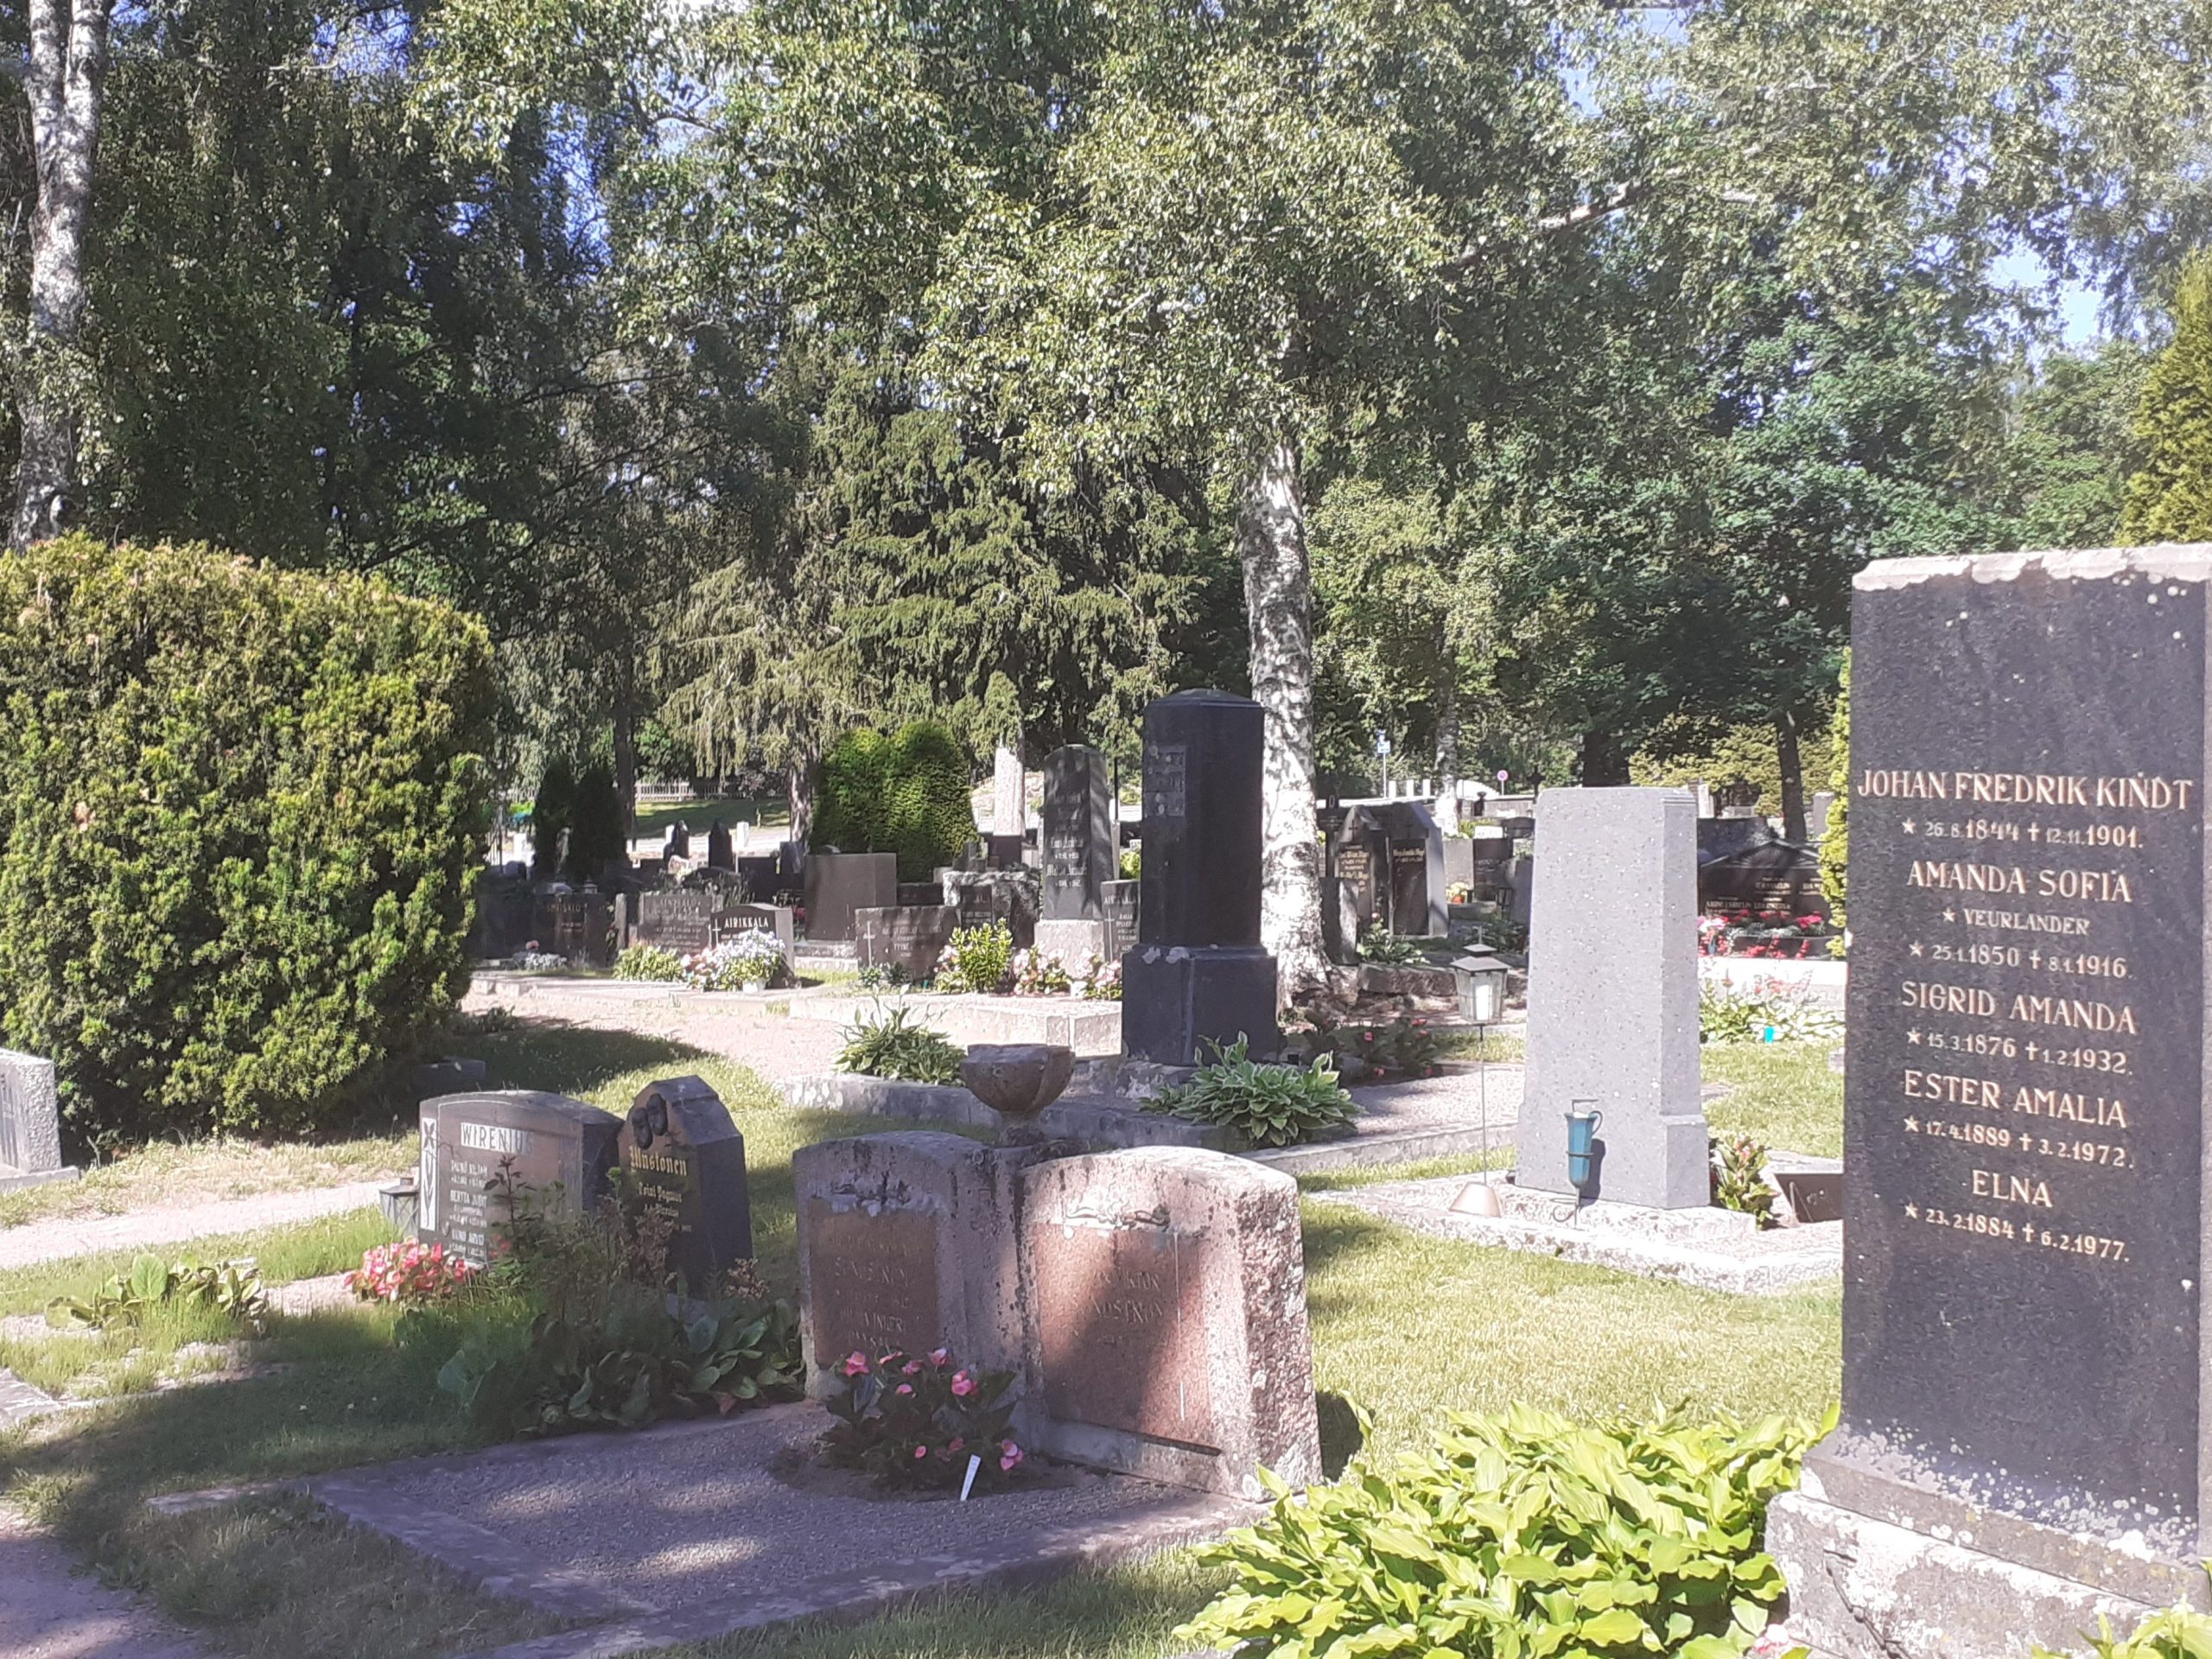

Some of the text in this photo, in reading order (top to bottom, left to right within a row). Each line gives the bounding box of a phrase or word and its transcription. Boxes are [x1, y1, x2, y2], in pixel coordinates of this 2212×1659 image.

[1857, 769, 2195, 811] JOHAN FREDRIK KINDT
[1906, 860, 2133, 903] AMANDA SOFIA
[1901, 981, 2139, 1035] SIGRID AMANDA
[1904, 1069, 2128, 1129] ESTER AMALIA
[461, 1122, 532, 1155] WIRENIUS
[1972, 1169, 2054, 1209] ELNA
